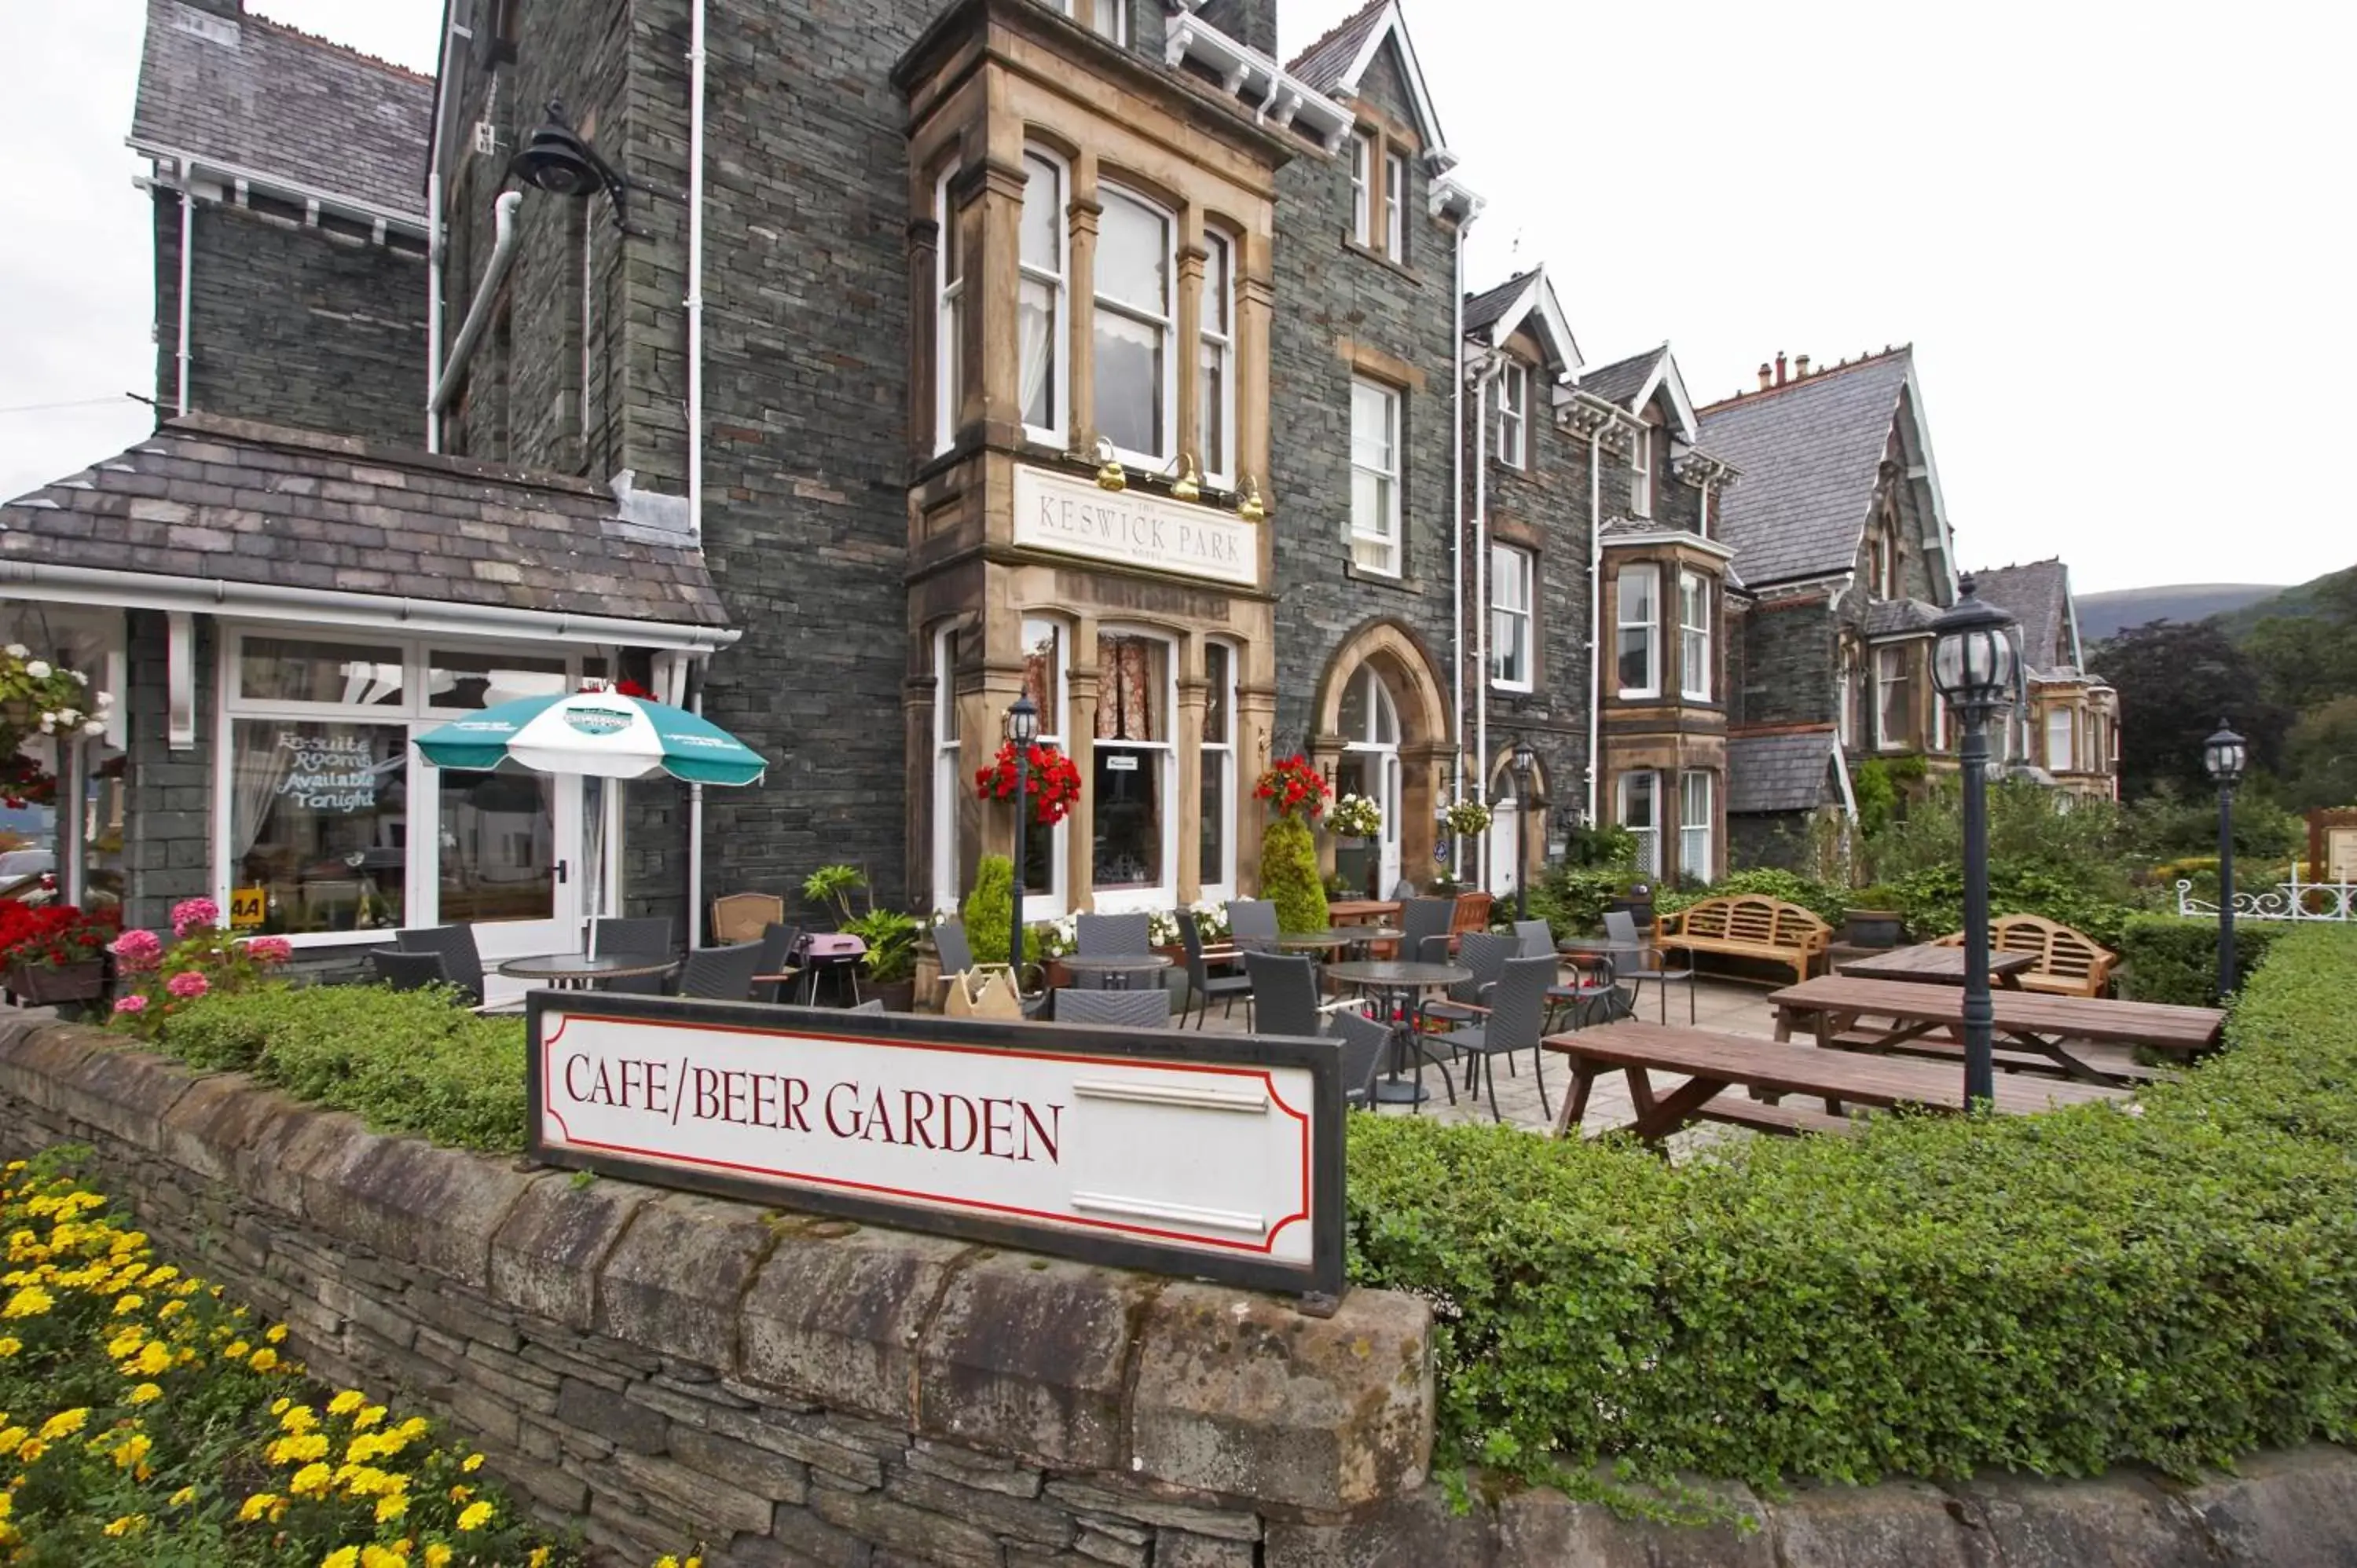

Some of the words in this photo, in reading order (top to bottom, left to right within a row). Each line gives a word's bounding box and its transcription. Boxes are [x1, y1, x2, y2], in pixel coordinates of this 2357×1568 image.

[1039, 495, 1165, 550] KESWICK
[1179, 525, 1240, 562] PARK
[291, 752, 372, 772] Rooms
[277, 771, 376, 794] Available
[290, 789, 376, 812] Tonight
[565, 1052, 812, 1133] CAFE/BEER
[824, 1081, 1065, 1167] GARDEN
